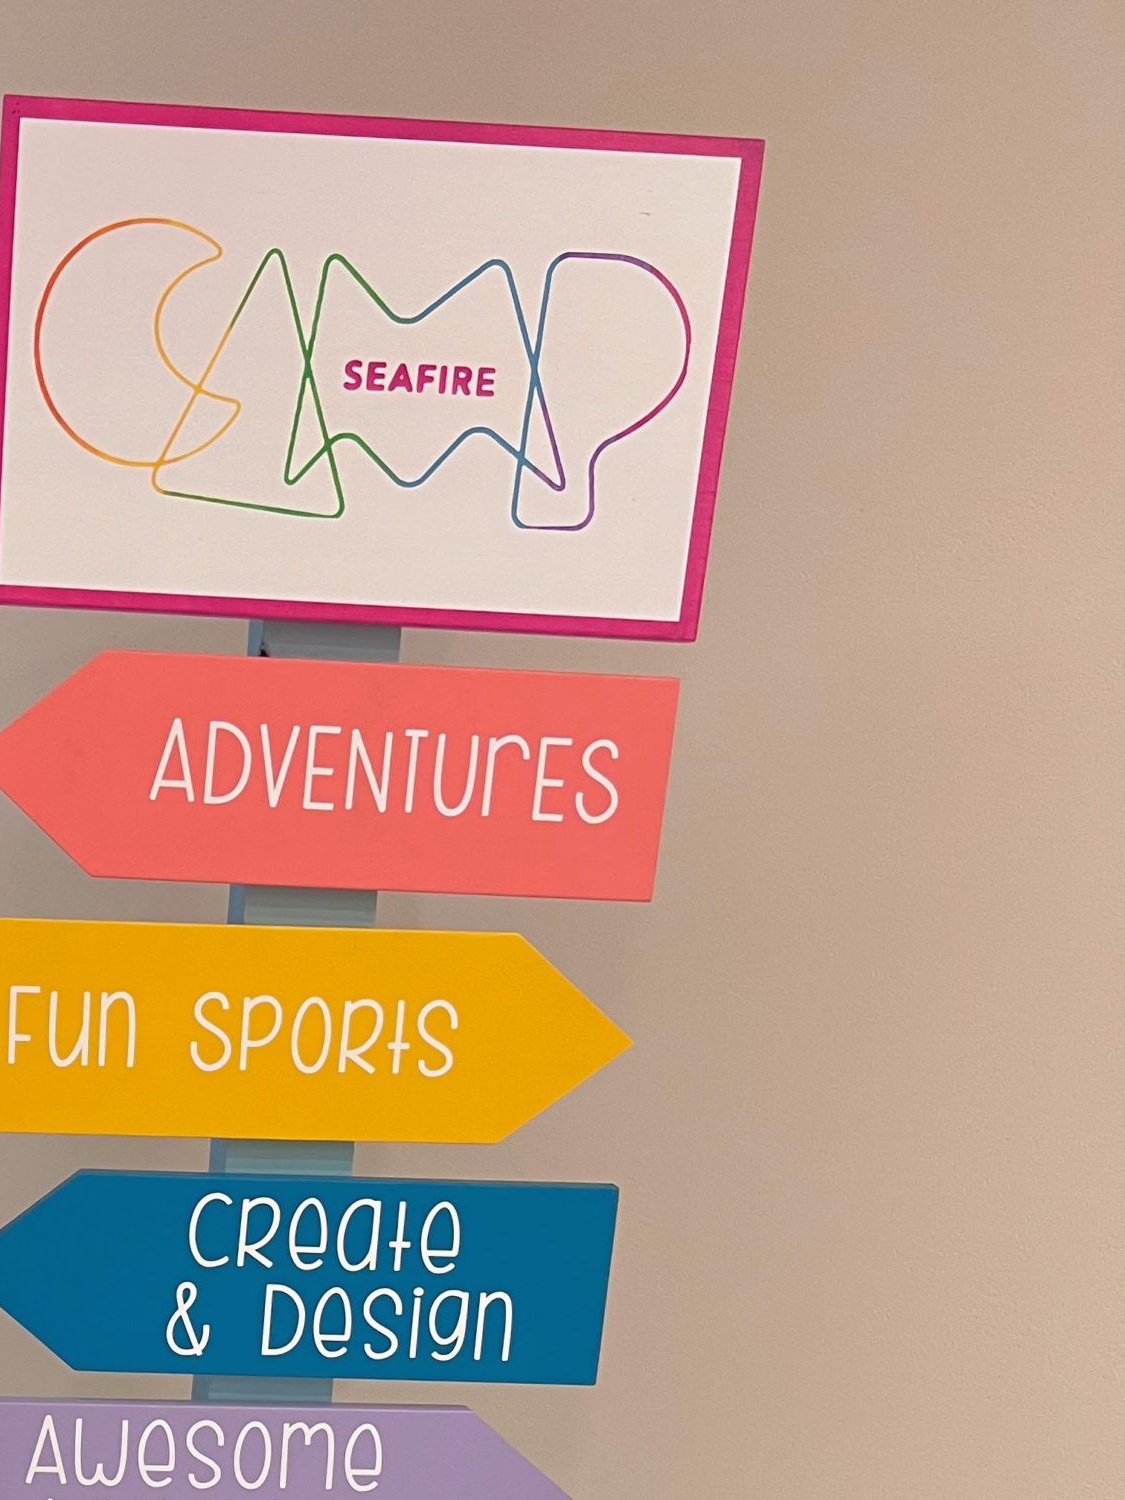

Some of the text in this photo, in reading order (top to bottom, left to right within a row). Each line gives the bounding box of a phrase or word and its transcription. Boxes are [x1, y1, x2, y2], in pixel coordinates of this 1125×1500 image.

[33, 216, 692, 531] CAMP
[343, 359, 497, 398] SEAFIRE
[166, 1281, 210, 1357] &
